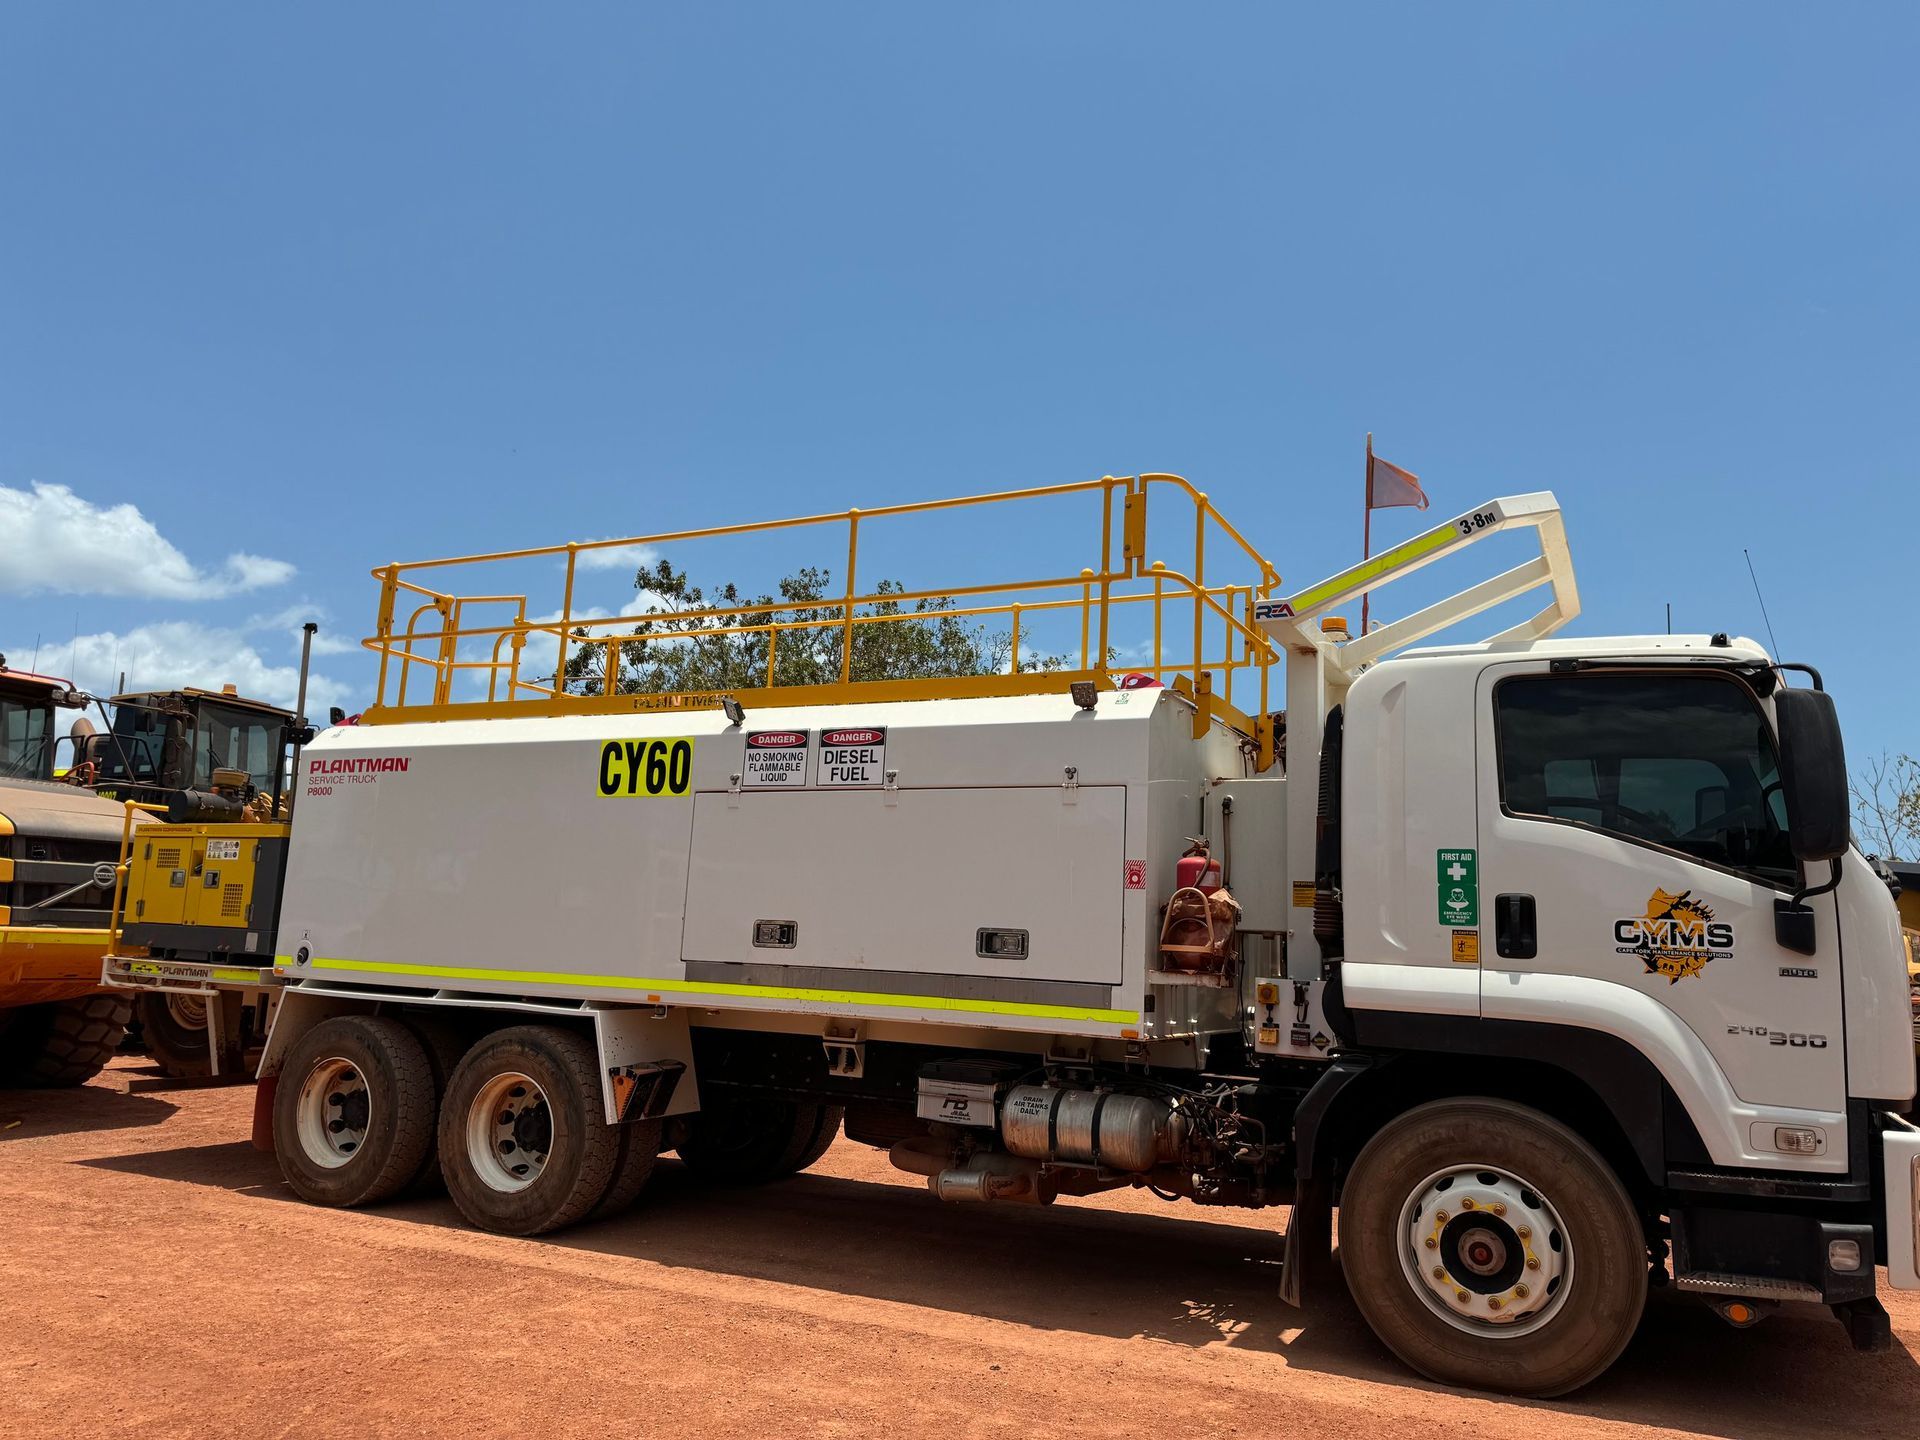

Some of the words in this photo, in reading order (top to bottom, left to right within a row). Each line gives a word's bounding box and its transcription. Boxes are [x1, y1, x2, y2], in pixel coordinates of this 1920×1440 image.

[1256, 603, 1296, 620] REA
[757, 735, 797, 744] DANGER
[832, 732, 873, 742] DANGER
[747, 753, 761, 762] NO
[762, 752, 804, 762] SMOKING
[823, 749, 879, 765] DIESEL
[600, 739, 692, 796] CY60
[748, 762, 801, 772] FLAMMABLE
[760, 773, 788, 782] LIQUID
[830, 767, 870, 781] FUEL
[308, 775, 345, 785] SERVICE
[347, 774, 378, 784] TRUCK
[307, 786, 333, 796] P8000
[1441, 853, 1460, 861] FIRST
[1460, 853, 1473, 861] AID
[1614, 919, 1734, 949] CYMS
[162, 966, 209, 978] PLANTMAN
[1780, 968, 1816, 977] AUTO
[1769, 1031, 1828, 1049] 300
[1020, 1107, 1040, 1115] DAILY
[1027, 1102, 1049, 1110] TANKS
